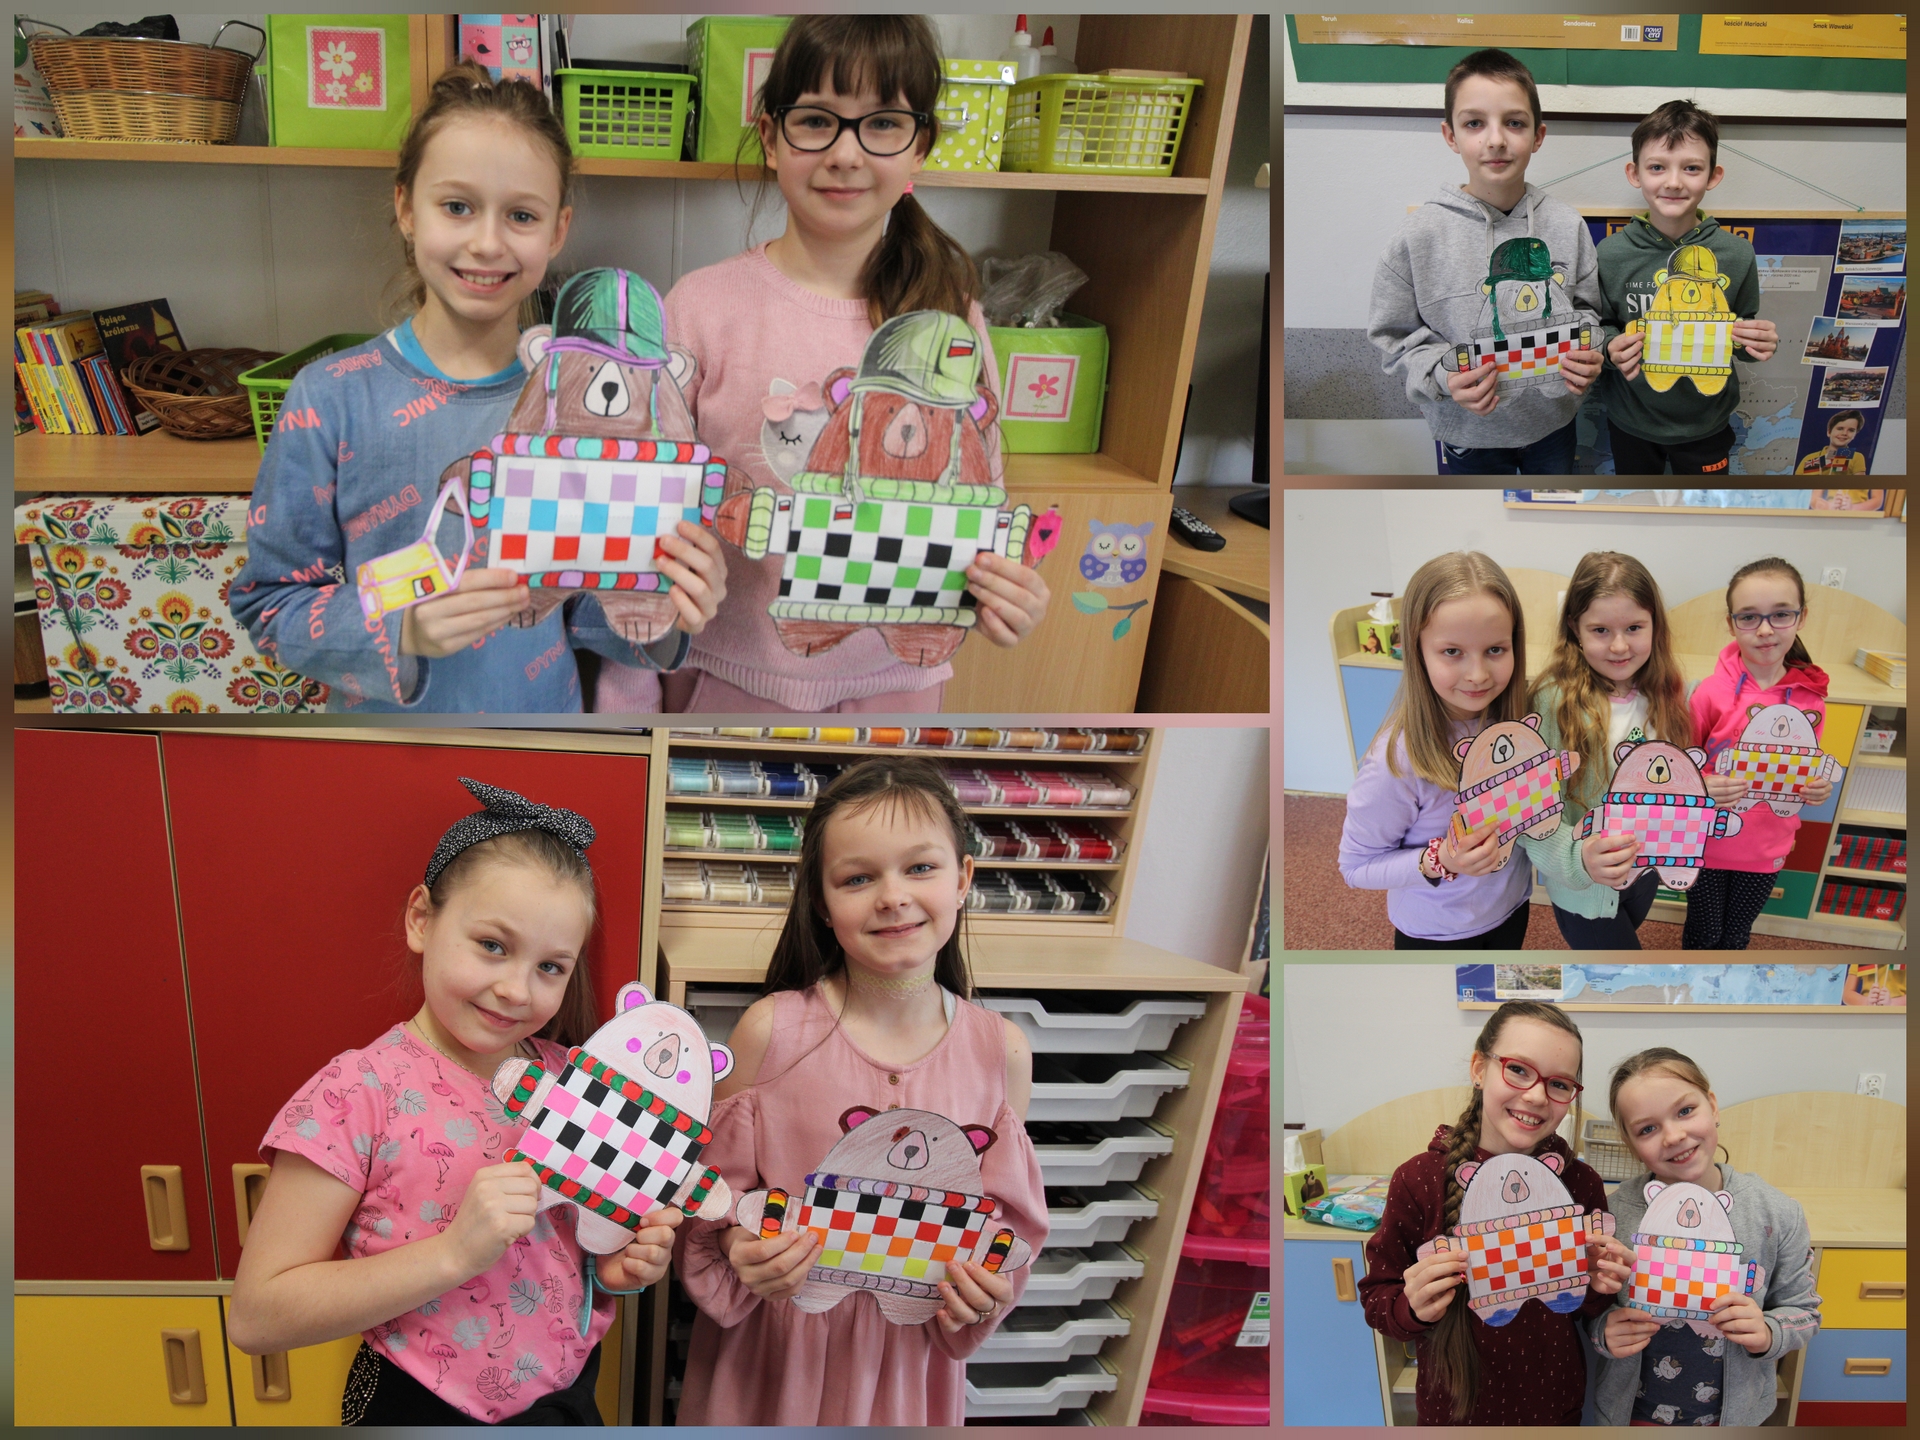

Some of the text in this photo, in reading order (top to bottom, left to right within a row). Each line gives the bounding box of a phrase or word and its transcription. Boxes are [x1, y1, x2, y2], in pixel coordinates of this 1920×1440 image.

[1625, 281, 1643, 289] TIME
[99, 314, 127, 327] Śpiąca
[103, 323, 140, 338] królewna
